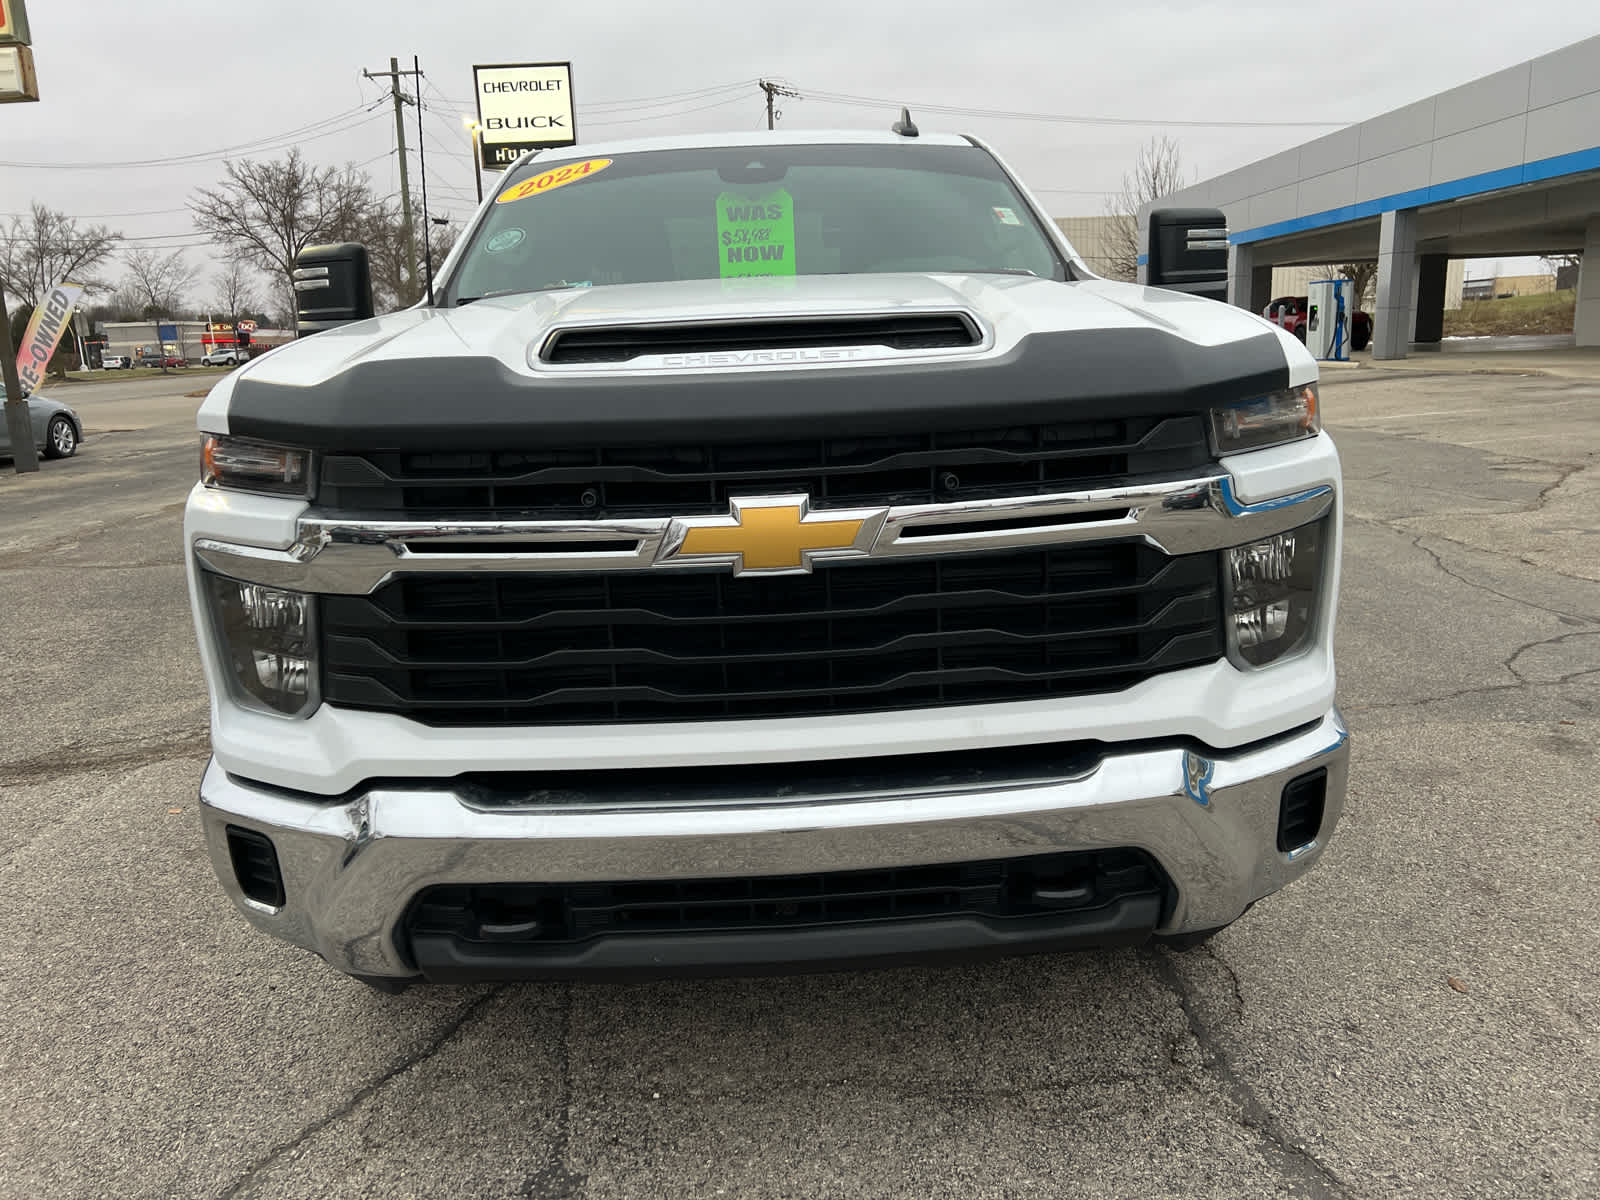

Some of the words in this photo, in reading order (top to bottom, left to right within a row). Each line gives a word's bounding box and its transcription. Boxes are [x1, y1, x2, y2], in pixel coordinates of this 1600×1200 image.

[484, 80, 562, 93] CHEVROLET
[487, 115, 566, 129] BUICK
[518, 162, 591, 197] 2024
[727, 205, 782, 222] WAS
[728, 245, 784, 263] NOW
[20, 290, 69, 393] RE-OWNED
[663, 349, 862, 366] CHEVROLET
